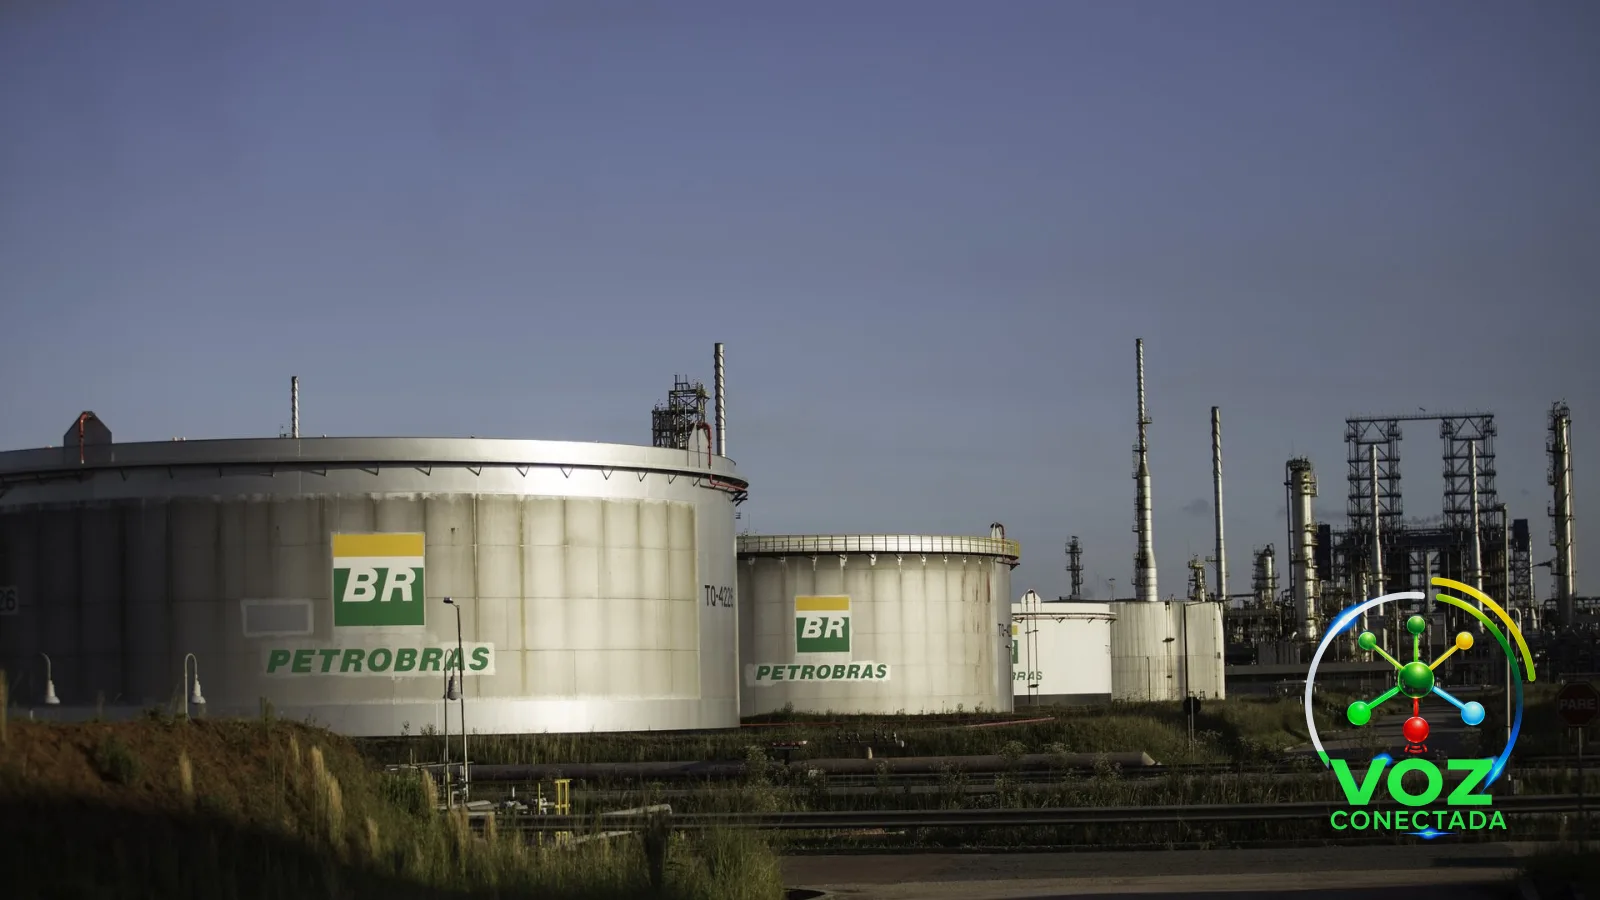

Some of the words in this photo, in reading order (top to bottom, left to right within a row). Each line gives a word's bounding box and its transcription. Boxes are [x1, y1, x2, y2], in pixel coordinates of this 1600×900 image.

[341, 566, 416, 602] BR
[801, 616, 846, 639] BR
[266, 647, 490, 674] PETROBRAS
[755, 663, 888, 681] PETROBRAS
[1560, 699, 1597, 710] PARE
